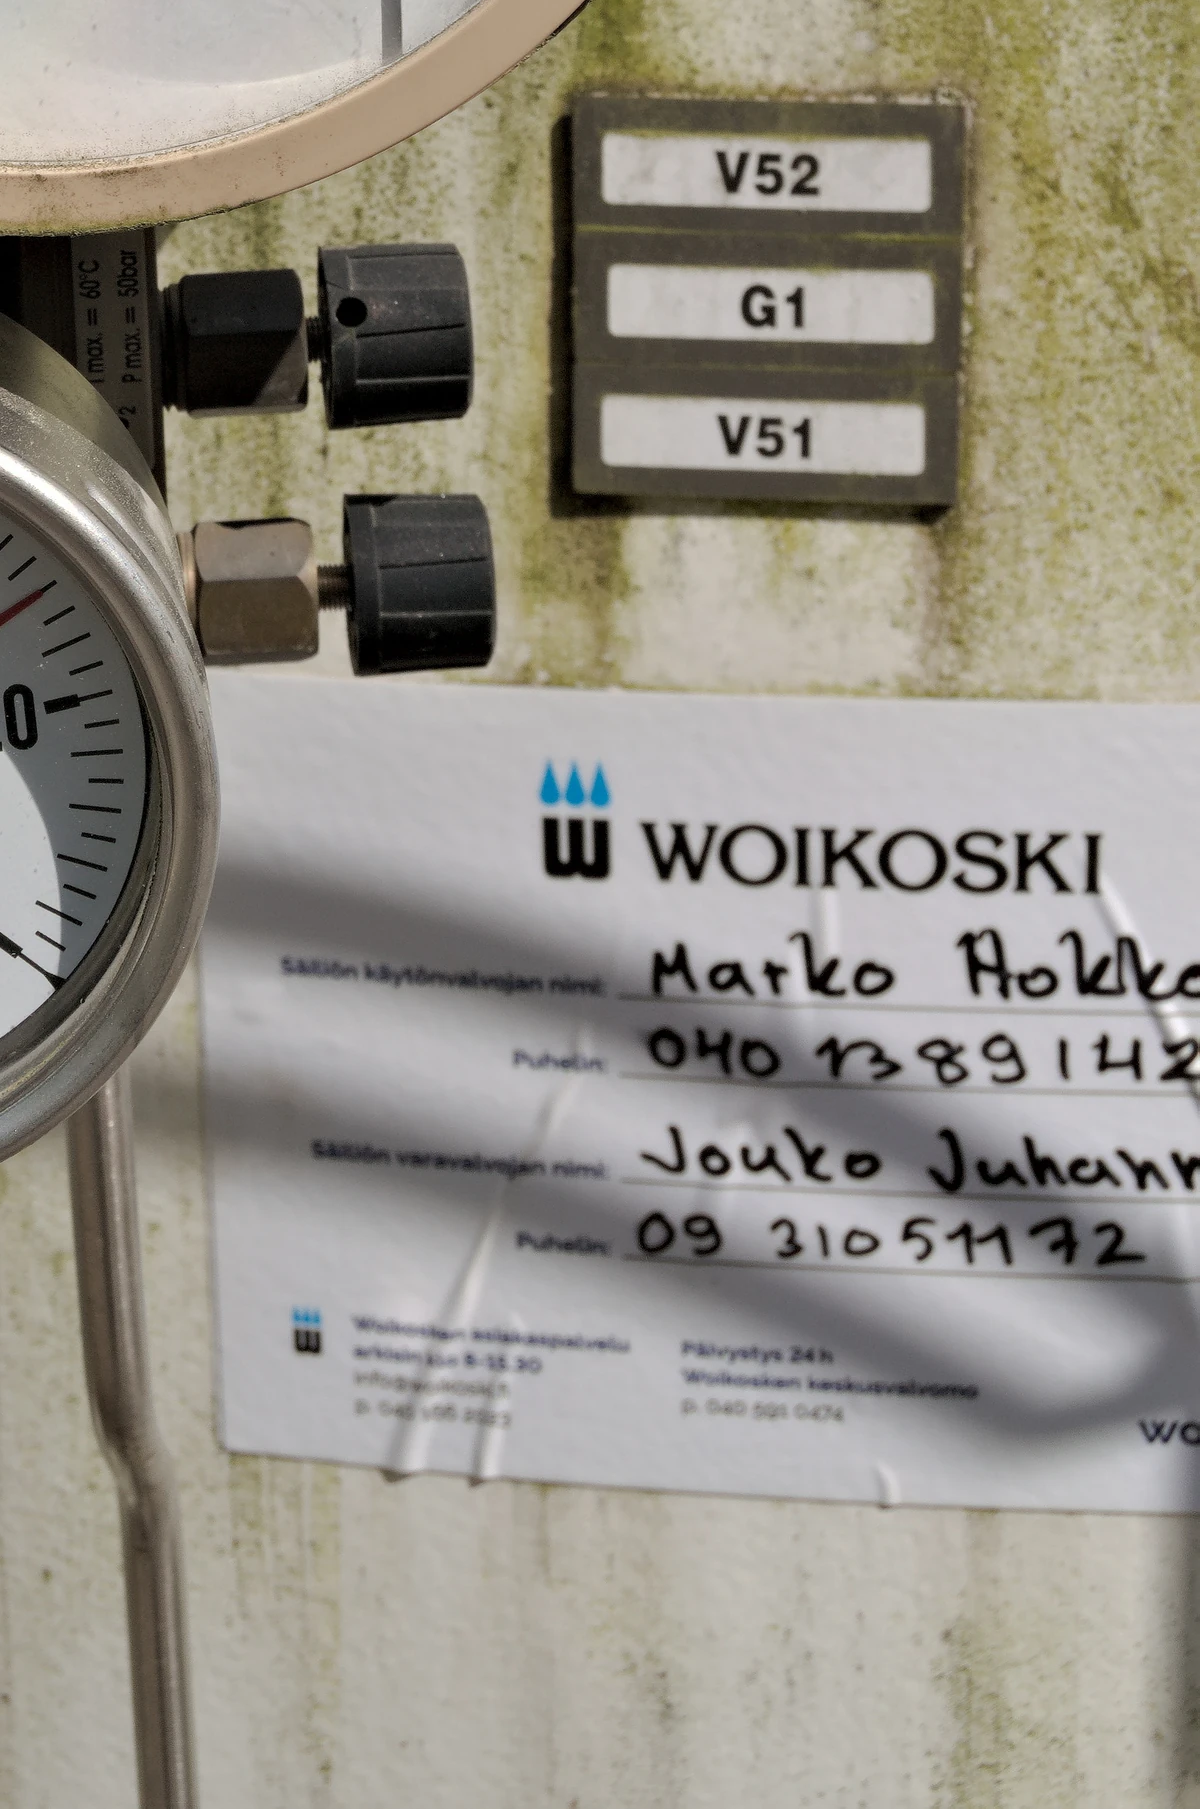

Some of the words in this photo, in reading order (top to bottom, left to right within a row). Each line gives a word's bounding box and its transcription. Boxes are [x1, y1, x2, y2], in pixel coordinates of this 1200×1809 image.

[715, 150, 820, 197] V52
[740, 284, 806, 328] G1
[717, 415, 813, 459] V51
[640, 821, 1105, 896] WOIKOSKI
[652, 930, 896, 999] Marko
[647, 1025, 782, 1080] 040
[640, 1124, 884, 1184] Jouko
[636, 1210, 724, 1259] 09
